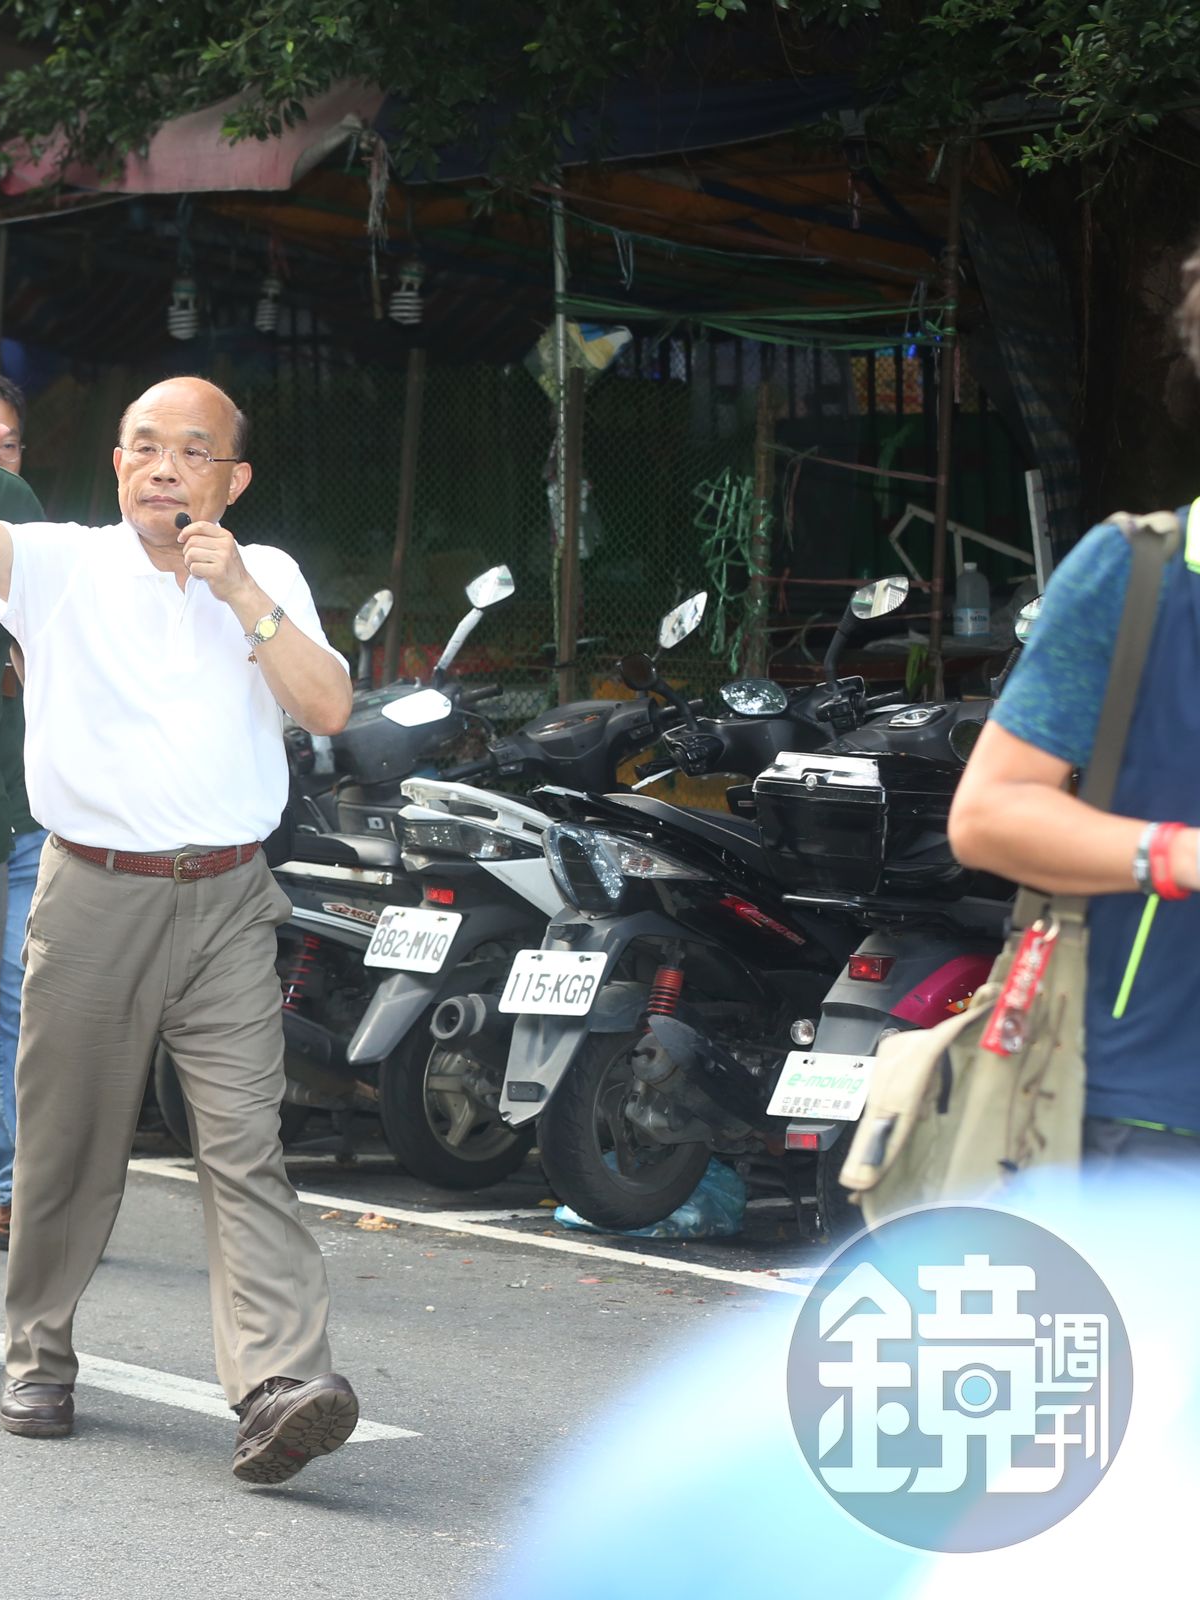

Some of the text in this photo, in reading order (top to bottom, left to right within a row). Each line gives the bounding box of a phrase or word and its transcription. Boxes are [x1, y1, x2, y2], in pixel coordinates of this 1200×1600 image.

[369, 926, 449, 962] 882-MVQ
[507, 972, 596, 1005] 115-KGR
[786, 1072, 865, 1095] e-moving
